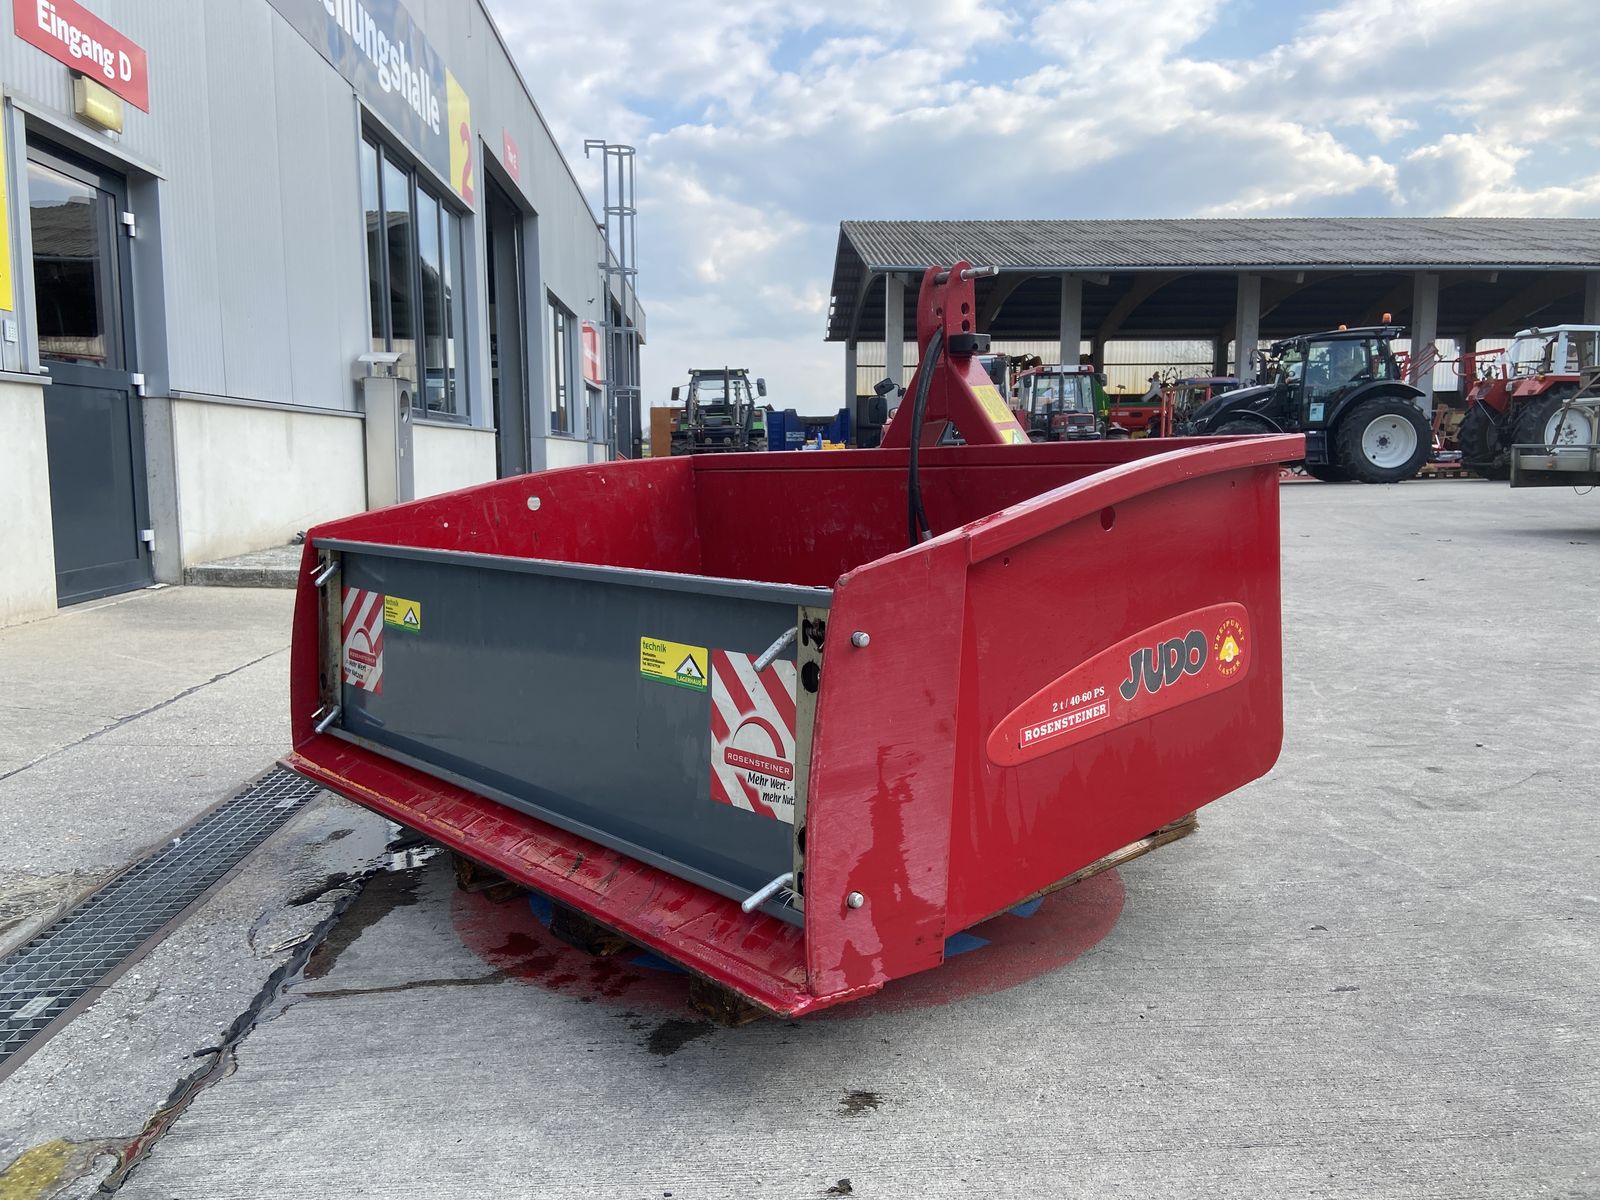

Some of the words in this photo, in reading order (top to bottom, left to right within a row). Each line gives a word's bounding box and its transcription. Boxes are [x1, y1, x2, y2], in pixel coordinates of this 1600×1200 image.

[37, 0, 115, 79] Eingang
[119, 50, 132, 82] D
[643, 640, 667, 653] technik
[1214, 620, 1245, 650] DREIPUNKT
[1225, 642, 1234, 662] 3
[1119, 630, 1208, 701] JUDO
[1218, 660, 1241, 675] LASTER
[1052, 702, 1058, 713] 2
[1060, 700, 1064, 710] t
[1070, 691, 1092, 706] 40-60
[1094, 686, 1105, 699] PS
[1024, 704, 1106, 742] ROSENSTEINER
[727, 752, 790, 775] ROSENSTEINER
[747, 772, 769, 787] Mehr
[770, 778, 786, 791] Wert
[762, 791, 783, 803] mehr
